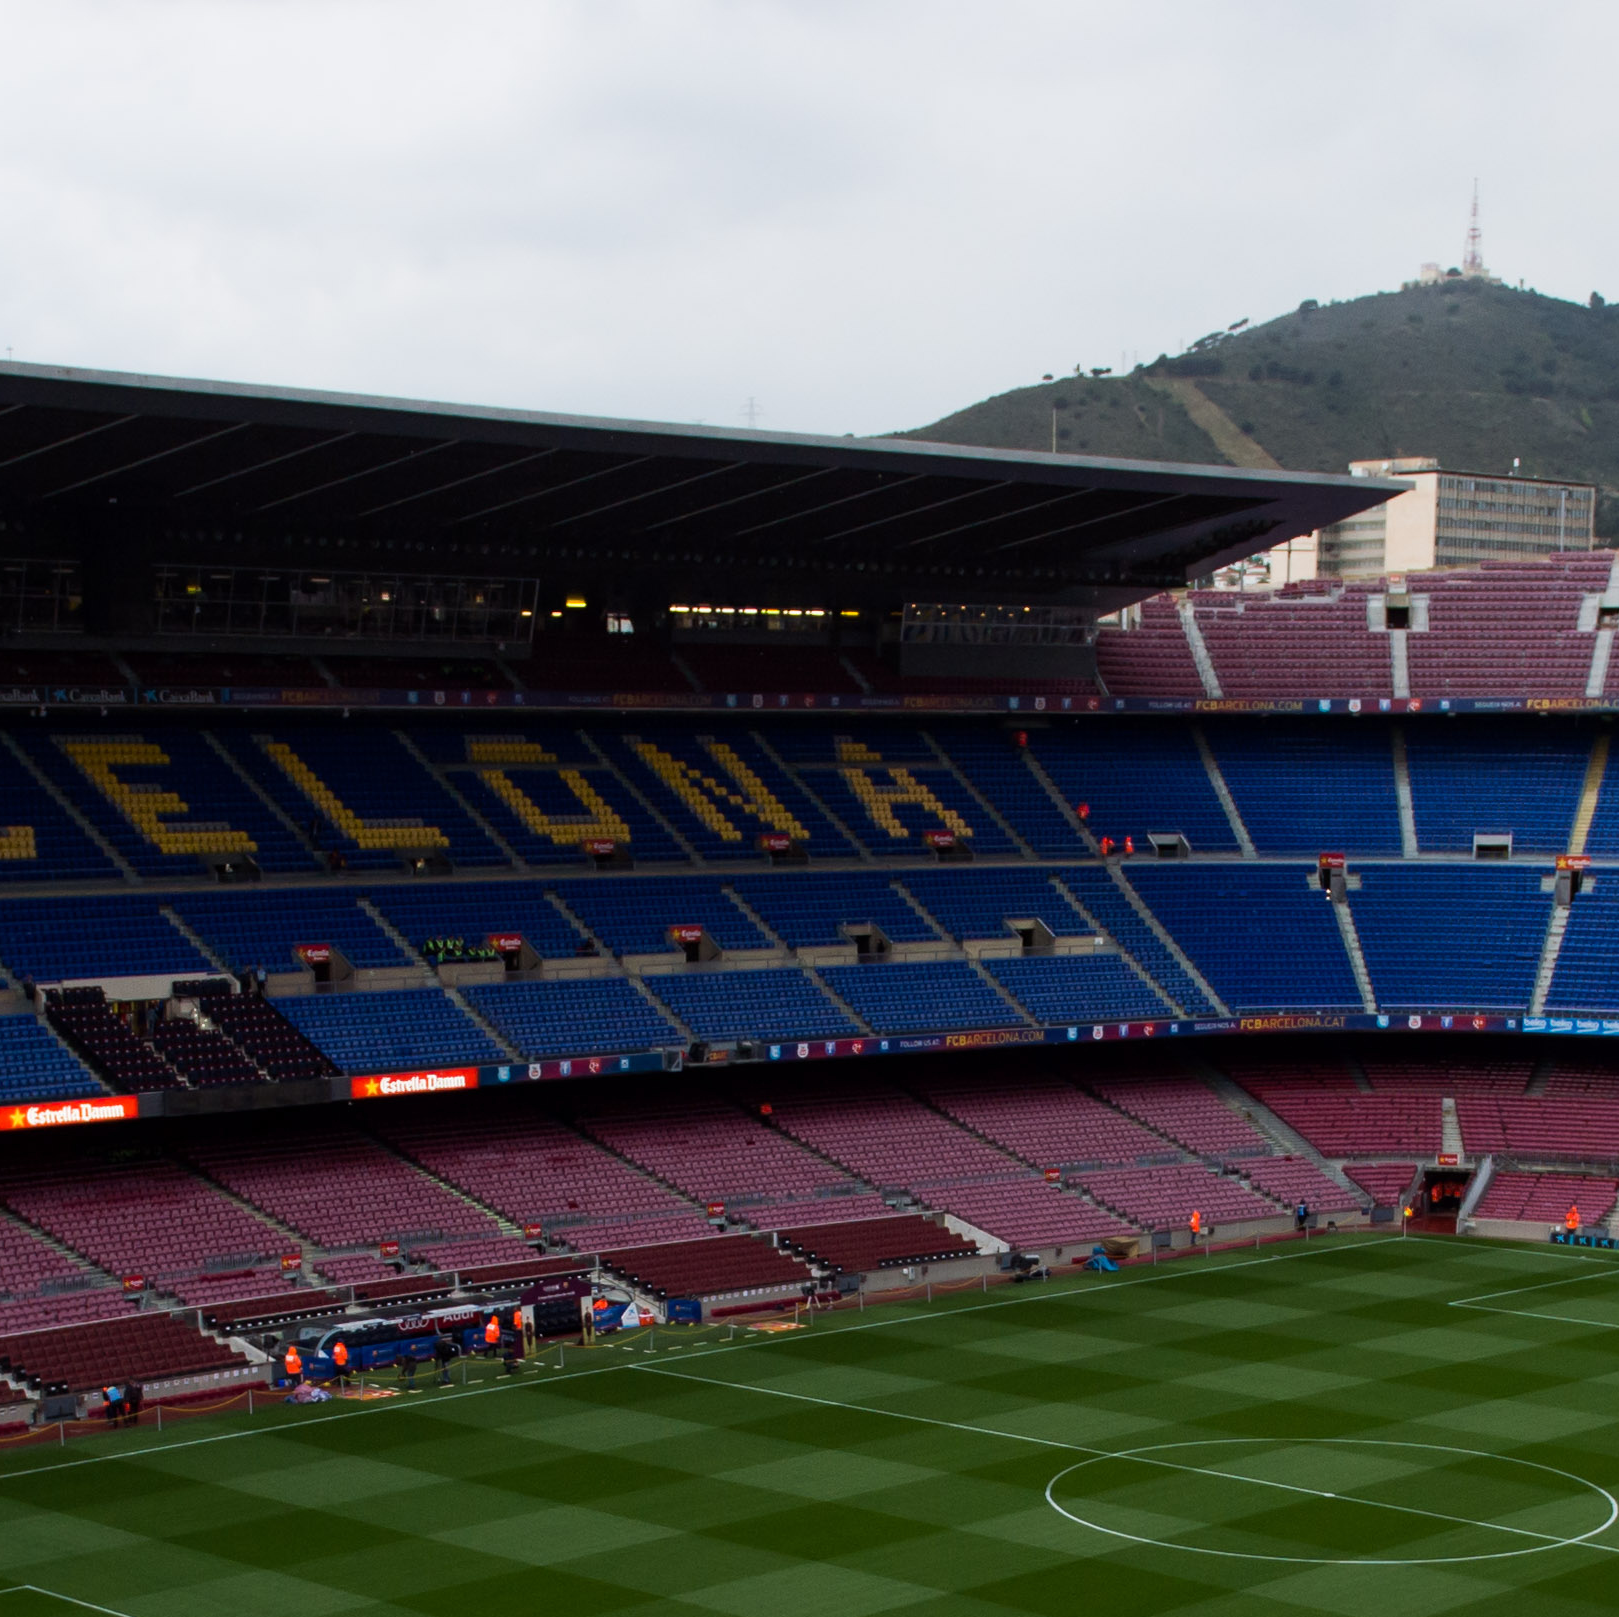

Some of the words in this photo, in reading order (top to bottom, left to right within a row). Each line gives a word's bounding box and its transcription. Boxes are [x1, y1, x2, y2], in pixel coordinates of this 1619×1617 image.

[379, 1076, 427, 1094] Estrella
[426, 1074, 466, 1091] Damm
[26, 1105, 80, 1126] Estrella
[80, 1103, 124, 1122] Damm
